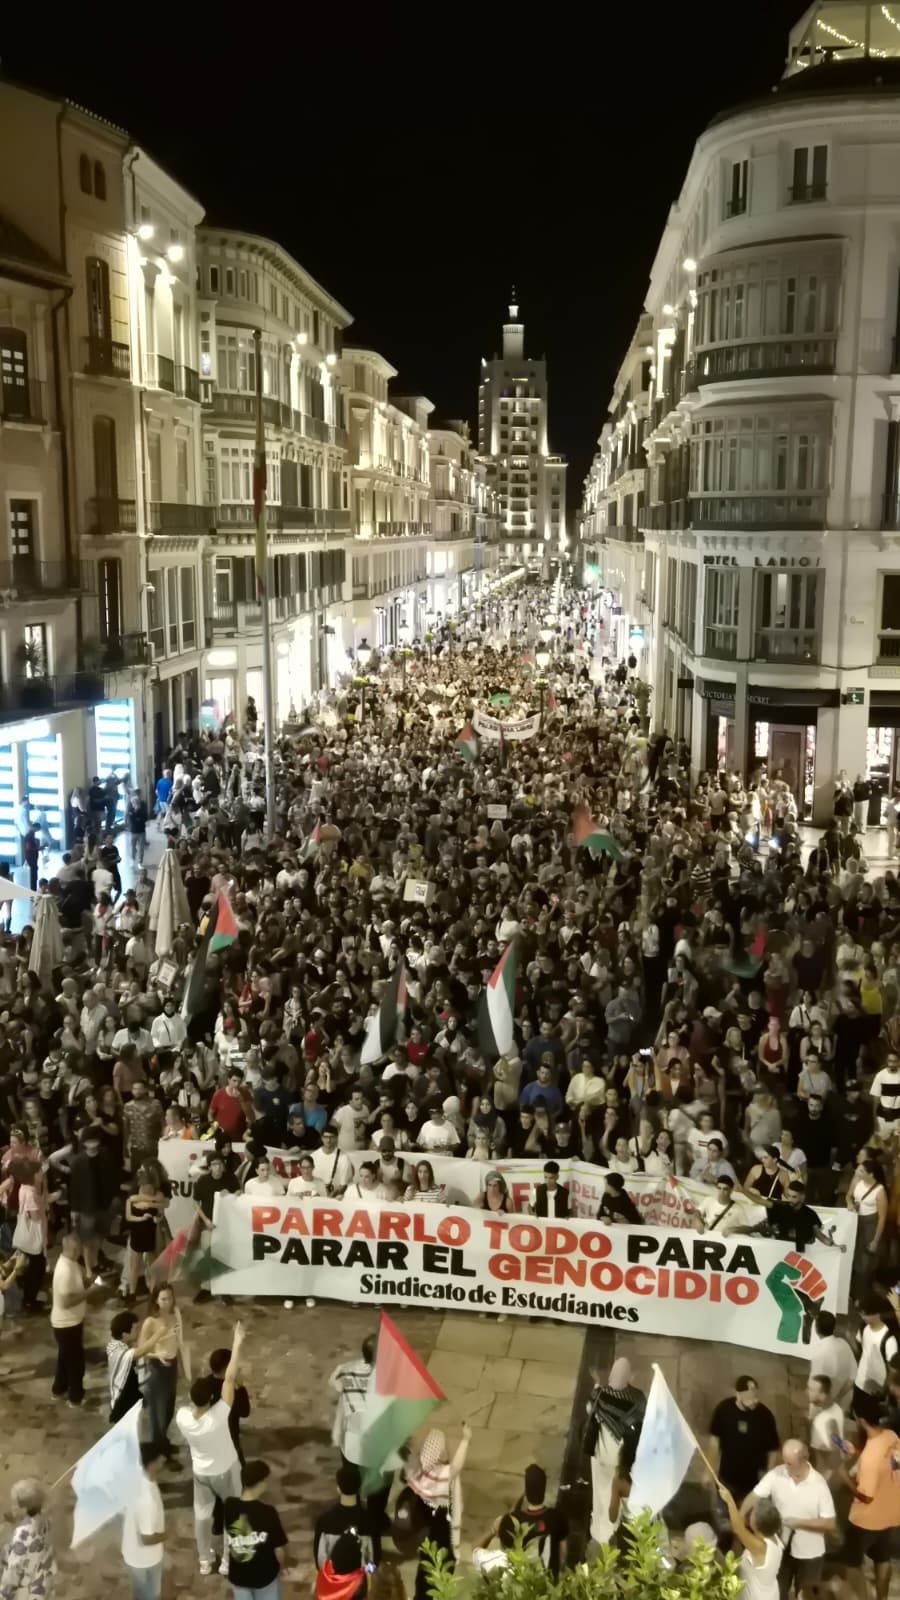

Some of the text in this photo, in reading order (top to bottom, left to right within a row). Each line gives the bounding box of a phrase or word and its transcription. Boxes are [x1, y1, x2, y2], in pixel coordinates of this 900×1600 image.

[252, 1207, 761, 1275] PARARLO TODO PARA
[252, 1234, 759, 1305] PARAR EL GENOCIDIO
[360, 1274, 640, 1324] Sindicato de Estudiantes
